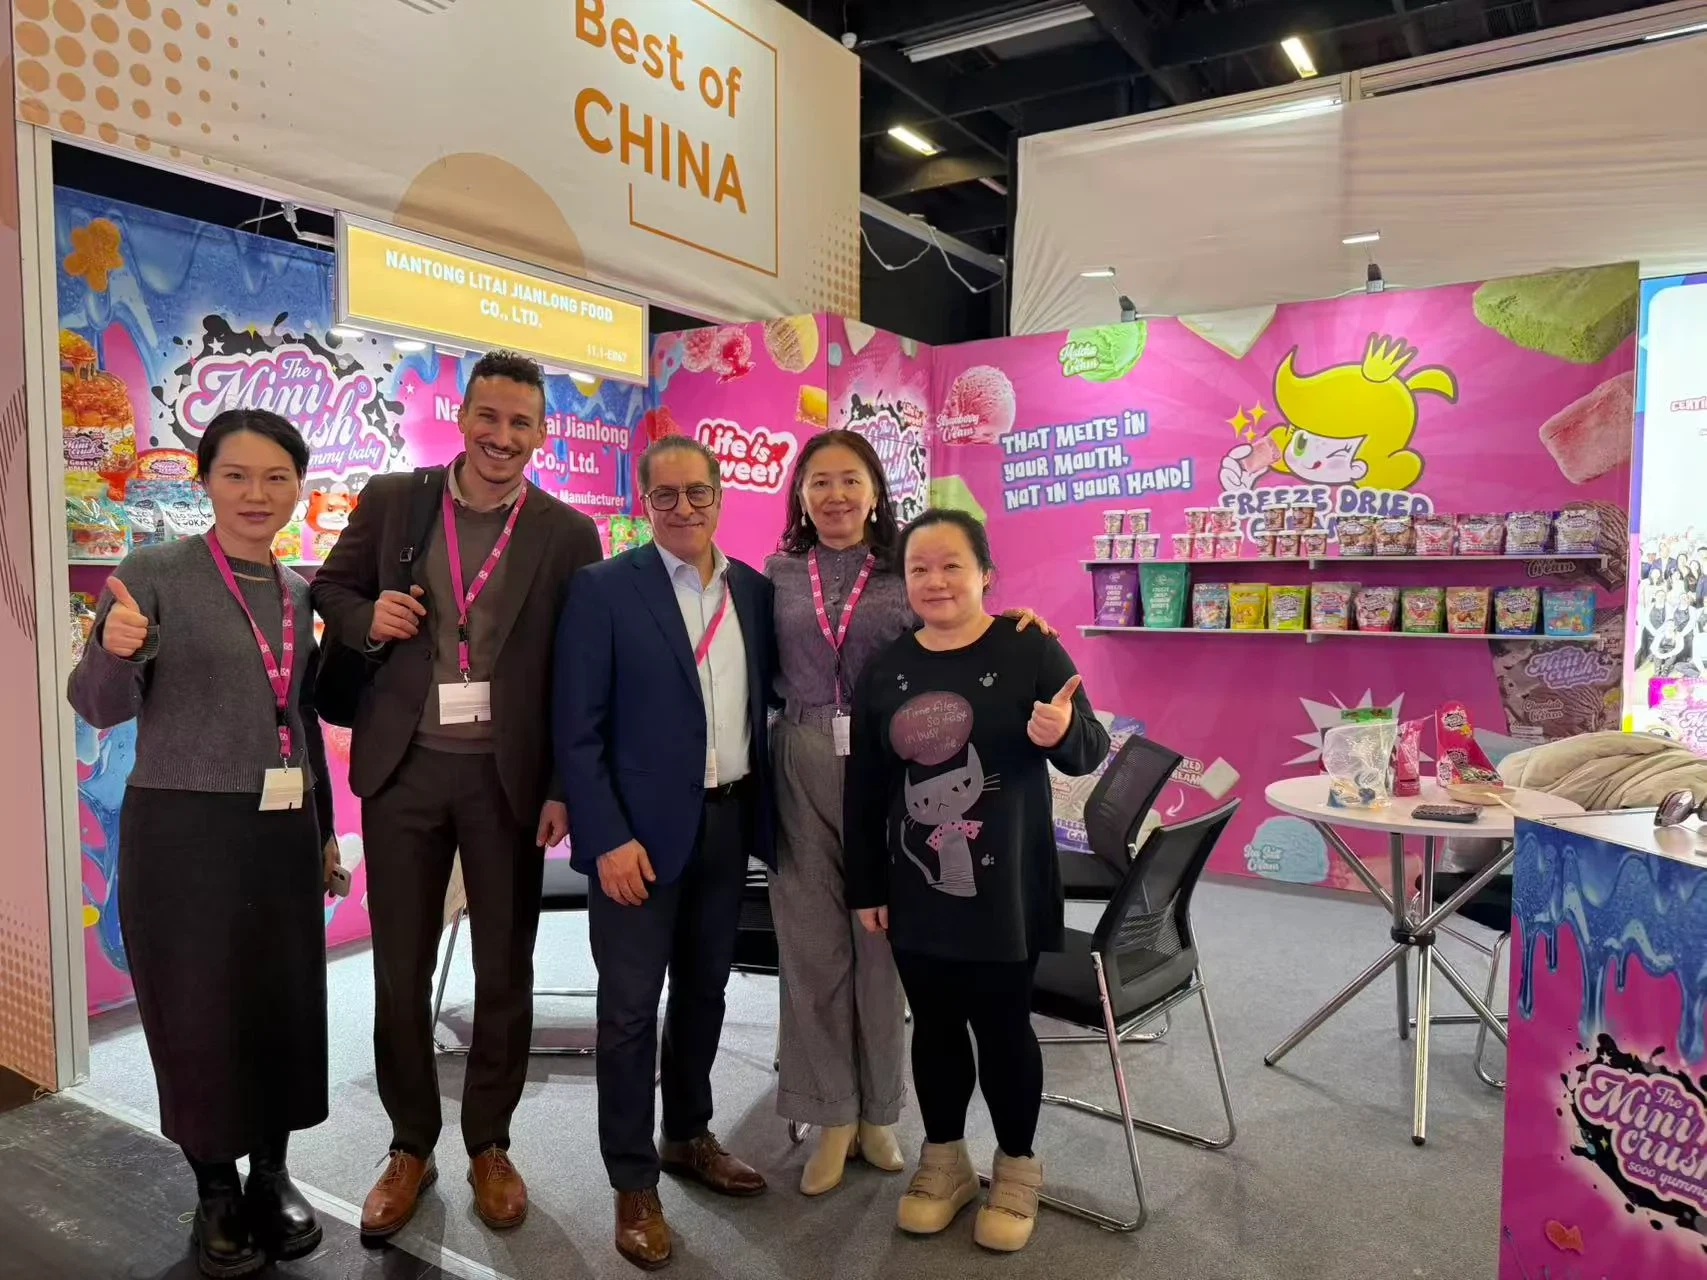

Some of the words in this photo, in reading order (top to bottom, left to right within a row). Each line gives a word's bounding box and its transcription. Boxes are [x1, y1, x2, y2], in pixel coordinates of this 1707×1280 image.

[576, 0, 685, 91] Best
[699, 66, 742, 119] of
[575, 88, 747, 214] CHINA
[386, 250, 465, 285] NANTONG
[469, 271, 507, 297] LITAI
[511, 282, 577, 313] JIANLONG
[580, 302, 613, 322] FOOD
[480, 298, 509, 322] CO.,
[512, 309, 543, 328] LTD.
[281, 358, 312, 380] The
[190, 366, 328, 422] Mini
[1670, 397, 1707, 411] CERTI
[299, 389, 357, 448] ush
[564, 420, 629, 449] Jianlong
[701, 427, 748, 459] Life
[750, 435, 771, 463] is
[942, 425, 974, 442] Cream
[1002, 427, 1050, 454] THAT
[1056, 417, 1119, 448] MELTS
[347, 440, 381, 464] baby
[532, 447, 566, 473] Co.,
[569, 451, 599, 474] Ltd.
[1004, 457, 1048, 482] YOUR
[1054, 445, 1129, 476] MOUTH,
[719, 460, 781, 485] weet
[1005, 484, 1041, 509] NOT
[1046, 482, 1067, 504] IN
[1073, 475, 1121, 500] YOUR
[1126, 460, 1192, 495] HAND!
[560, 489, 625, 507] Manufacturer
[1222, 488, 1329, 516] FREEZE
[1339, 489, 1430, 517] DRIED
[1171, 769, 1201, 786] REAM
[1056, 818, 1086, 832] FREEZ
[1584, 1076, 1700, 1143] Mini
[1656, 1086, 1684, 1109] The
[1627, 1161, 1657, 1178] sooo
